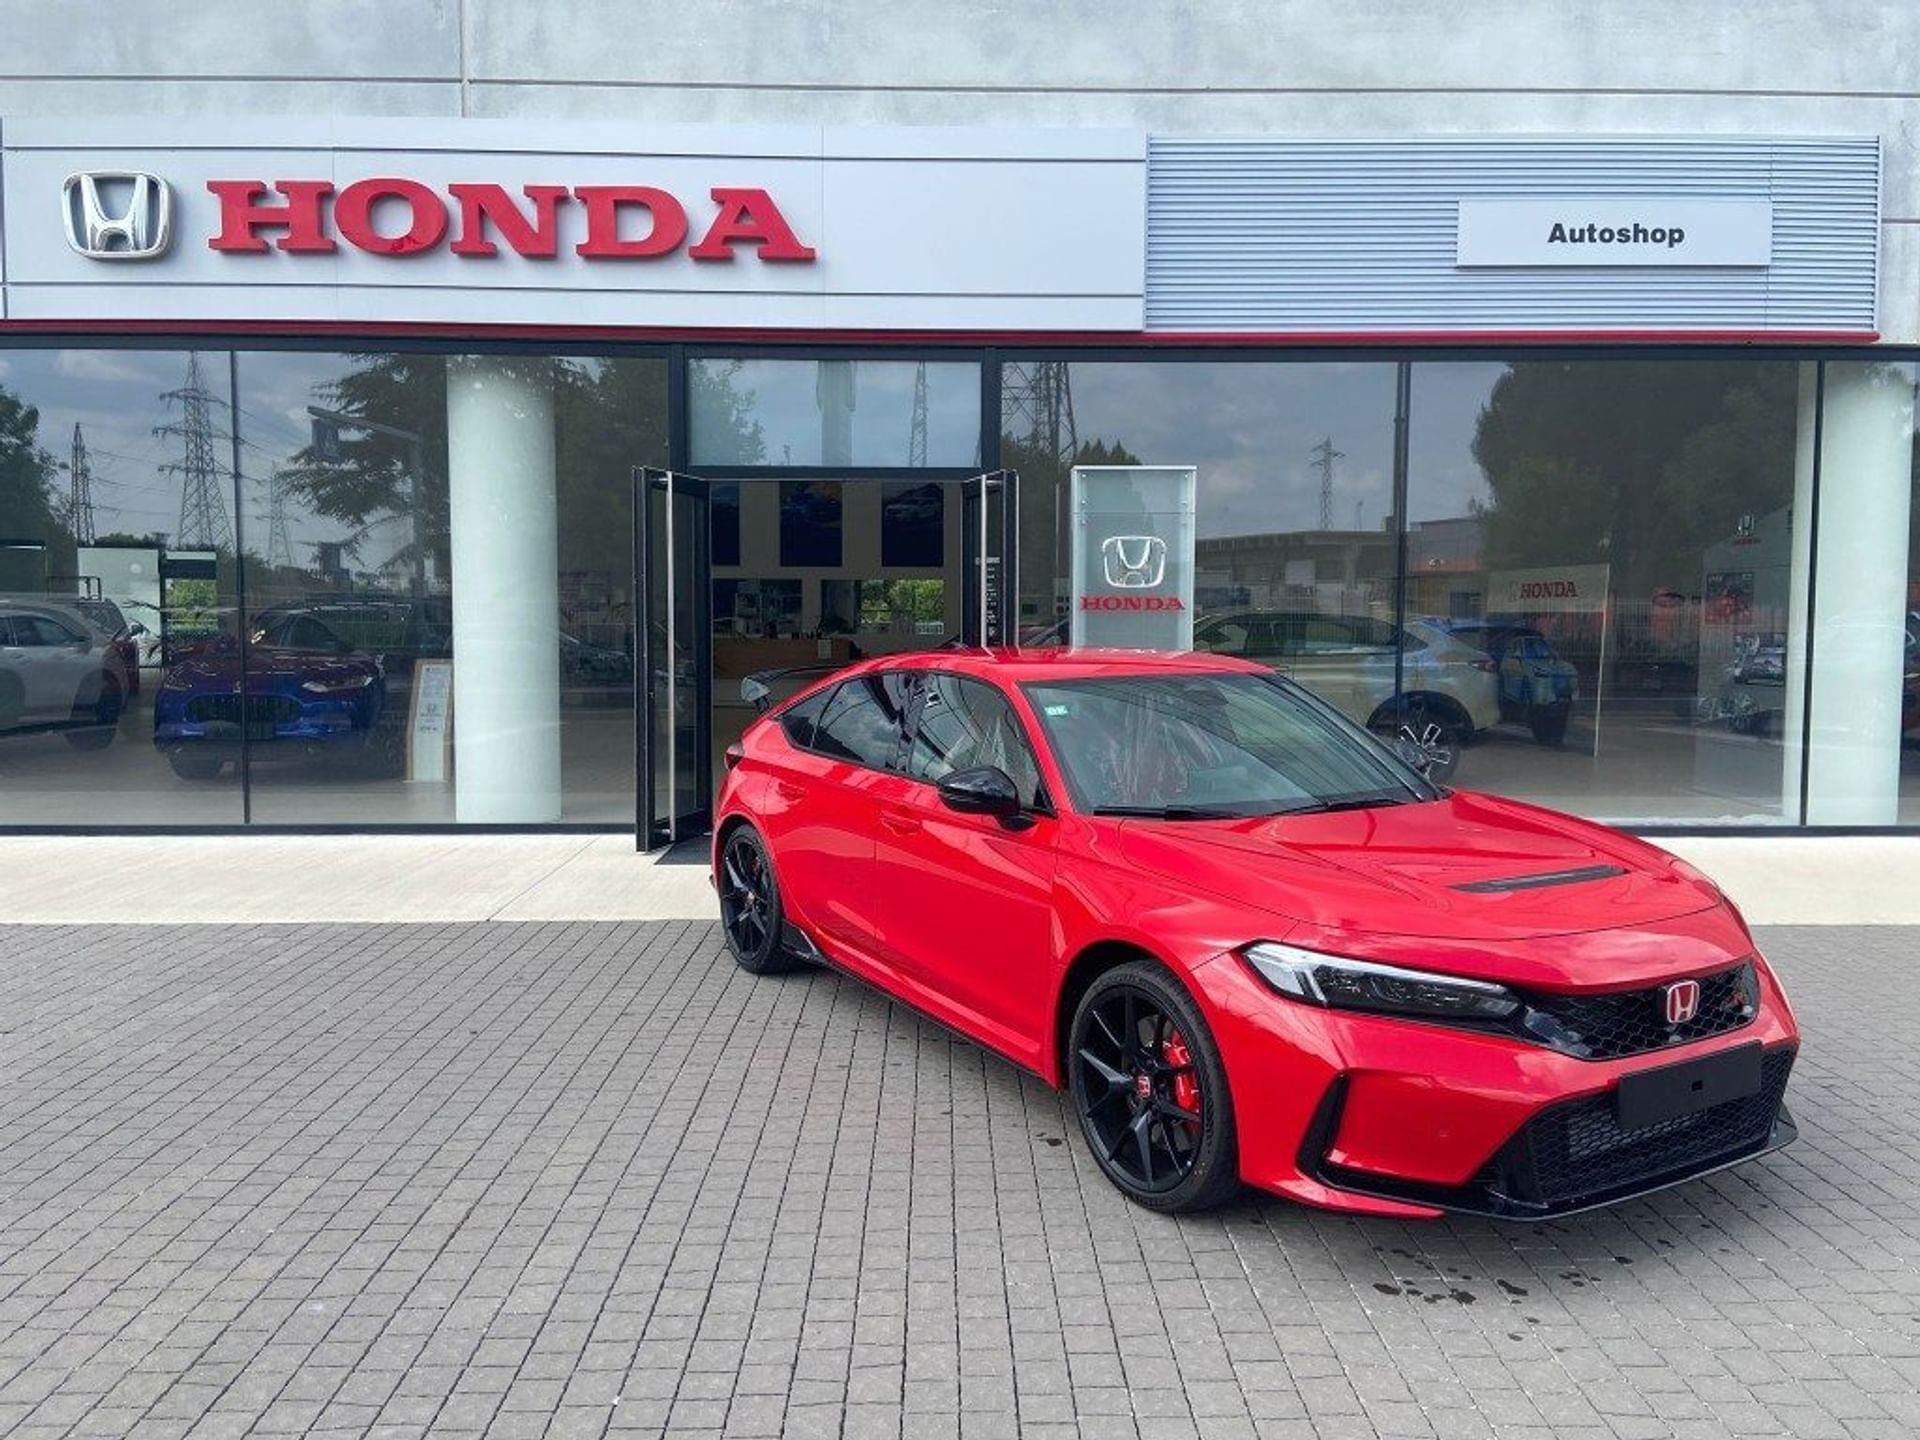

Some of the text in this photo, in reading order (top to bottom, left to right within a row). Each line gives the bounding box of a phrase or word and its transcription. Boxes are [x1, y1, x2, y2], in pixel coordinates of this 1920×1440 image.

[206, 177, 817, 262] HONDA
[1547, 222, 1686, 248] Autoshop
[1519, 579, 1578, 600] HONDA
[1080, 594, 1185, 612] HONDA
